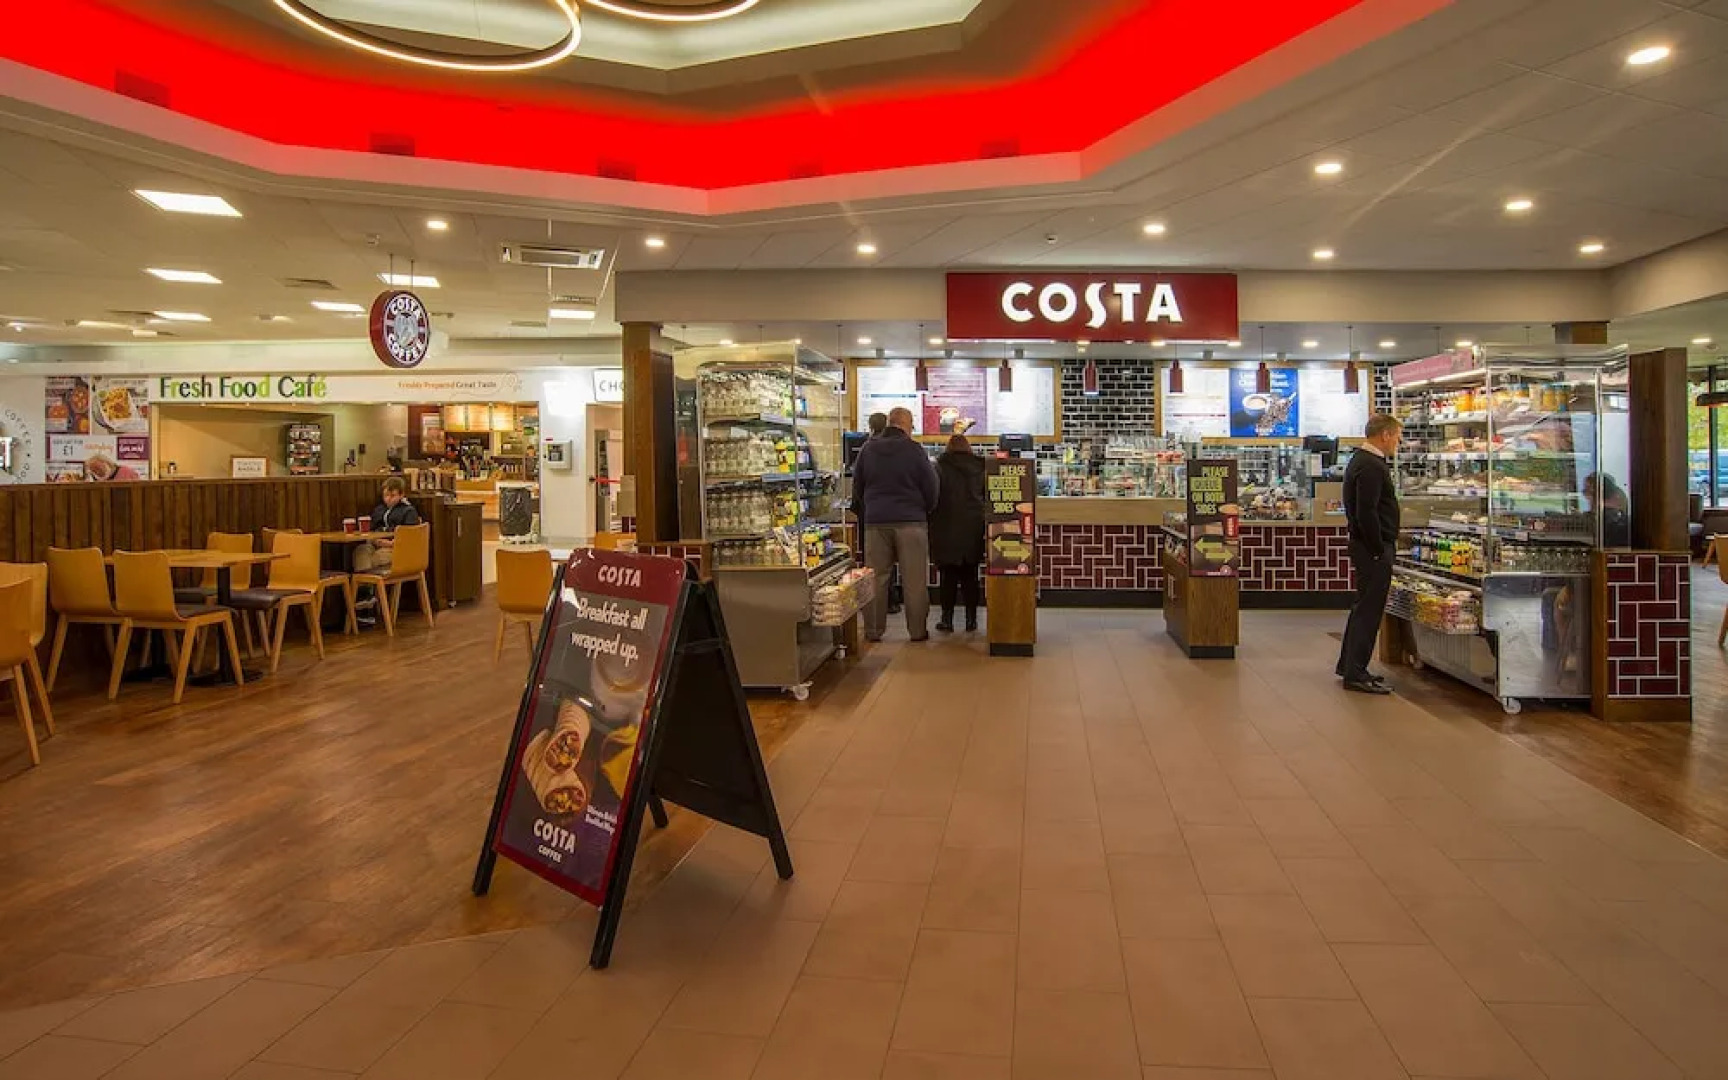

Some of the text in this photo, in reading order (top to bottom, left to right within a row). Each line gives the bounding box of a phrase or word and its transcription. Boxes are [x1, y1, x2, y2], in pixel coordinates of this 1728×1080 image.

[389, 297, 425, 320] COSTA
[1001, 281, 1184, 329] COSTA
[160, 373, 327, 398] Fresh Food Café
[999, 465, 1027, 476] PLEASE
[1202, 466, 1229, 478] PLEASE
[597, 565, 642, 587] COSTA
[577, 597, 648, 630] Breakfast all
[571, 632, 638, 668] wrapped up.
[533, 818, 576, 854] COSTA
[538, 844, 563, 863] COFFEE
